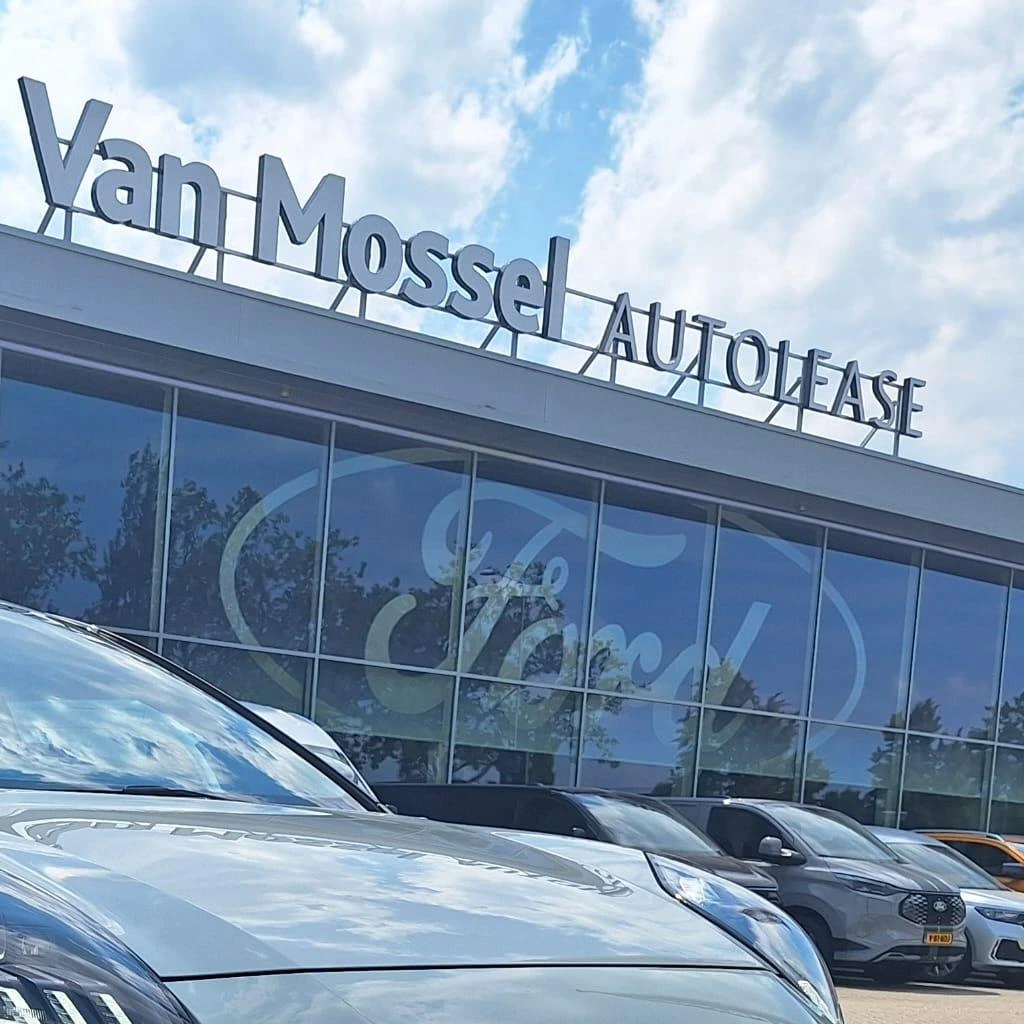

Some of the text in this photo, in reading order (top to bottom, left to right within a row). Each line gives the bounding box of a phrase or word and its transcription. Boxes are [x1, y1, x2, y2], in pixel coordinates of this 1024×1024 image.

[17, 76, 927, 439] Van Mossel AUTOLEASE
[364, 481, 771, 752] Ford
